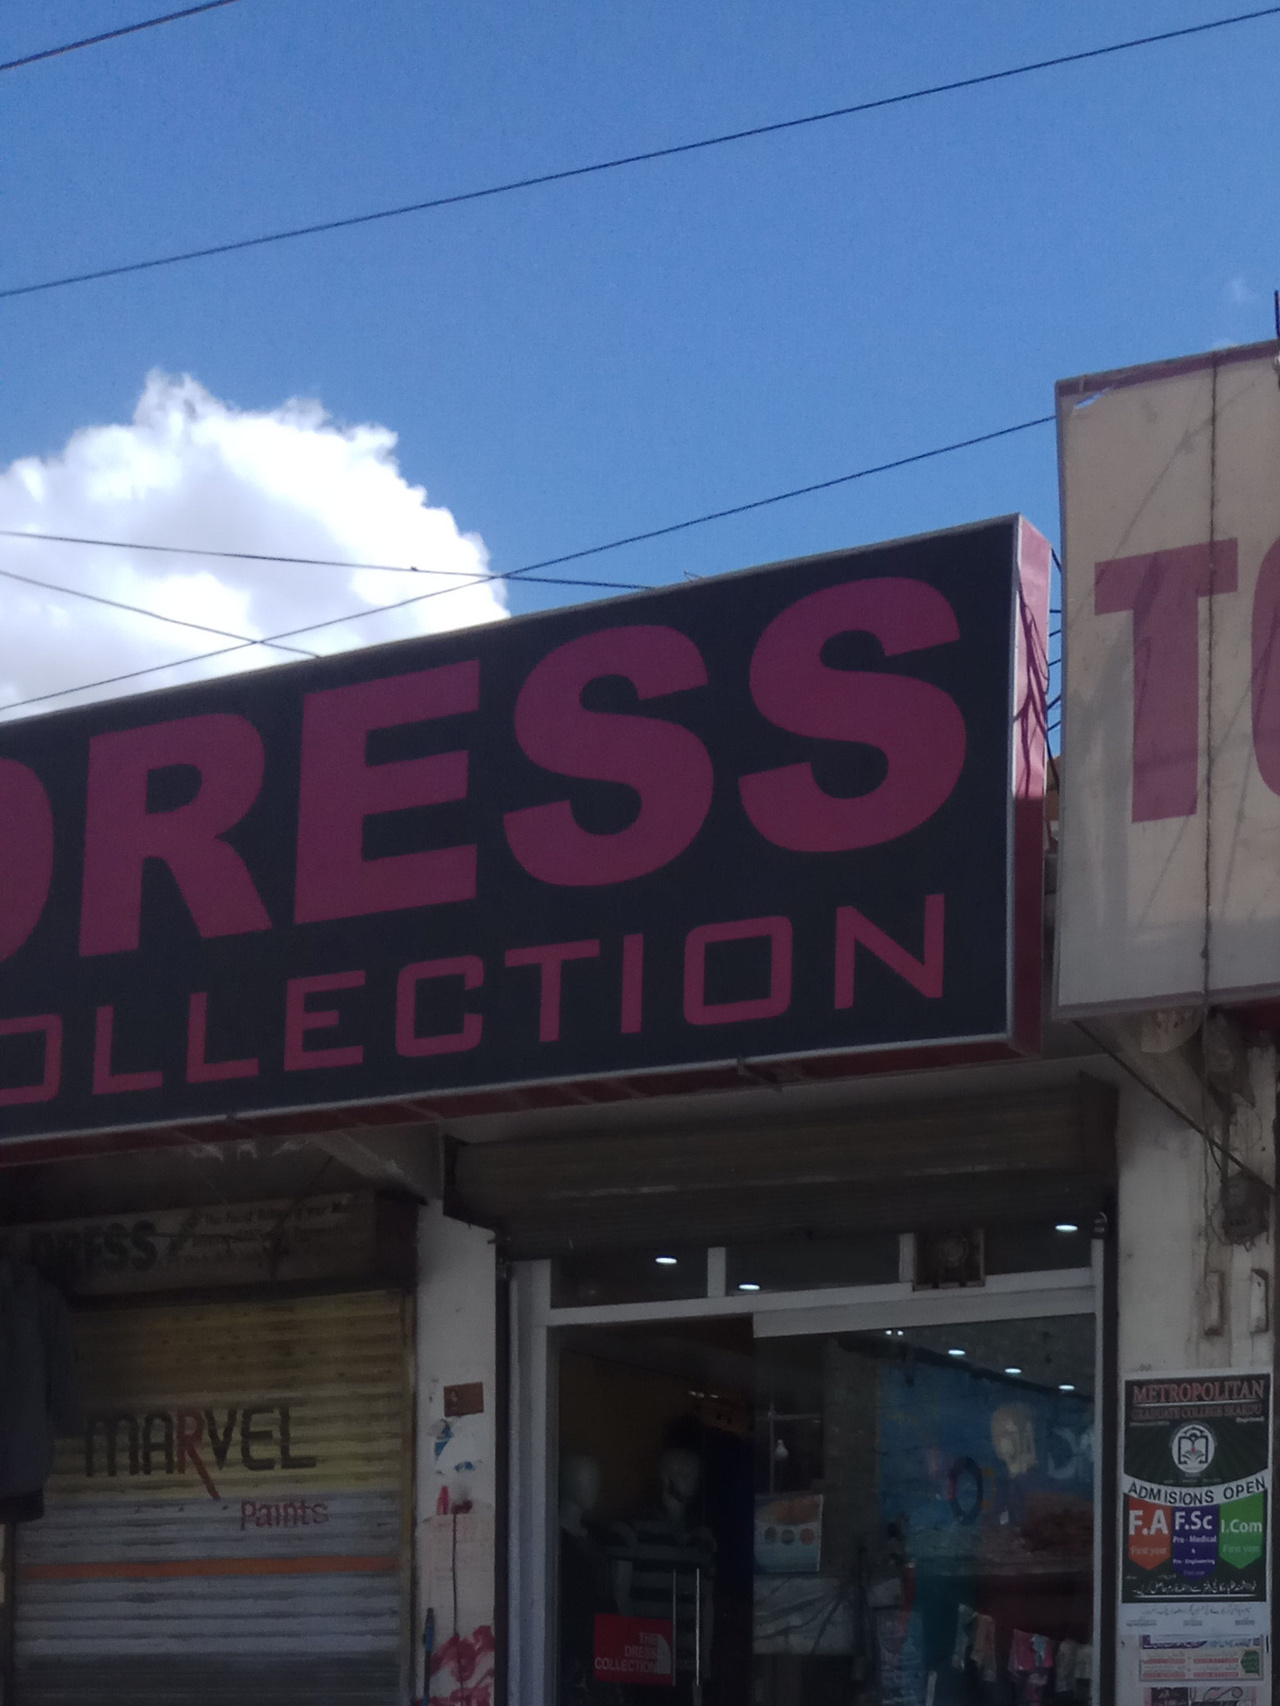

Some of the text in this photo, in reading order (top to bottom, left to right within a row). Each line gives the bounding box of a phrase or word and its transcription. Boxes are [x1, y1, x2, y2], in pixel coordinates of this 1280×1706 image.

[1132, 1380, 1264, 1404] METROPOLITAN
[1131, 1407, 1181, 1420] GRADUATE
[1181, 1405, 1223, 1418] COLLEGE
[85, 1402, 318, 1500] MARVEL
[1128, 1481, 1215, 1506] ADMISIONS
[1223, 1476, 1267, 1501] OPEN
[240, 1498, 330, 1530] Paints
[1128, 1509, 1169, 1536] F.A
[1174, 1510, 1213, 1531] F.Sc
[1220, 1518, 1263, 1534] I.Com
[639, 1631, 658, 1645] THE
[624, 1645, 660, 1660] DRESS
[594, 1656, 659, 1673] COLLECTION
